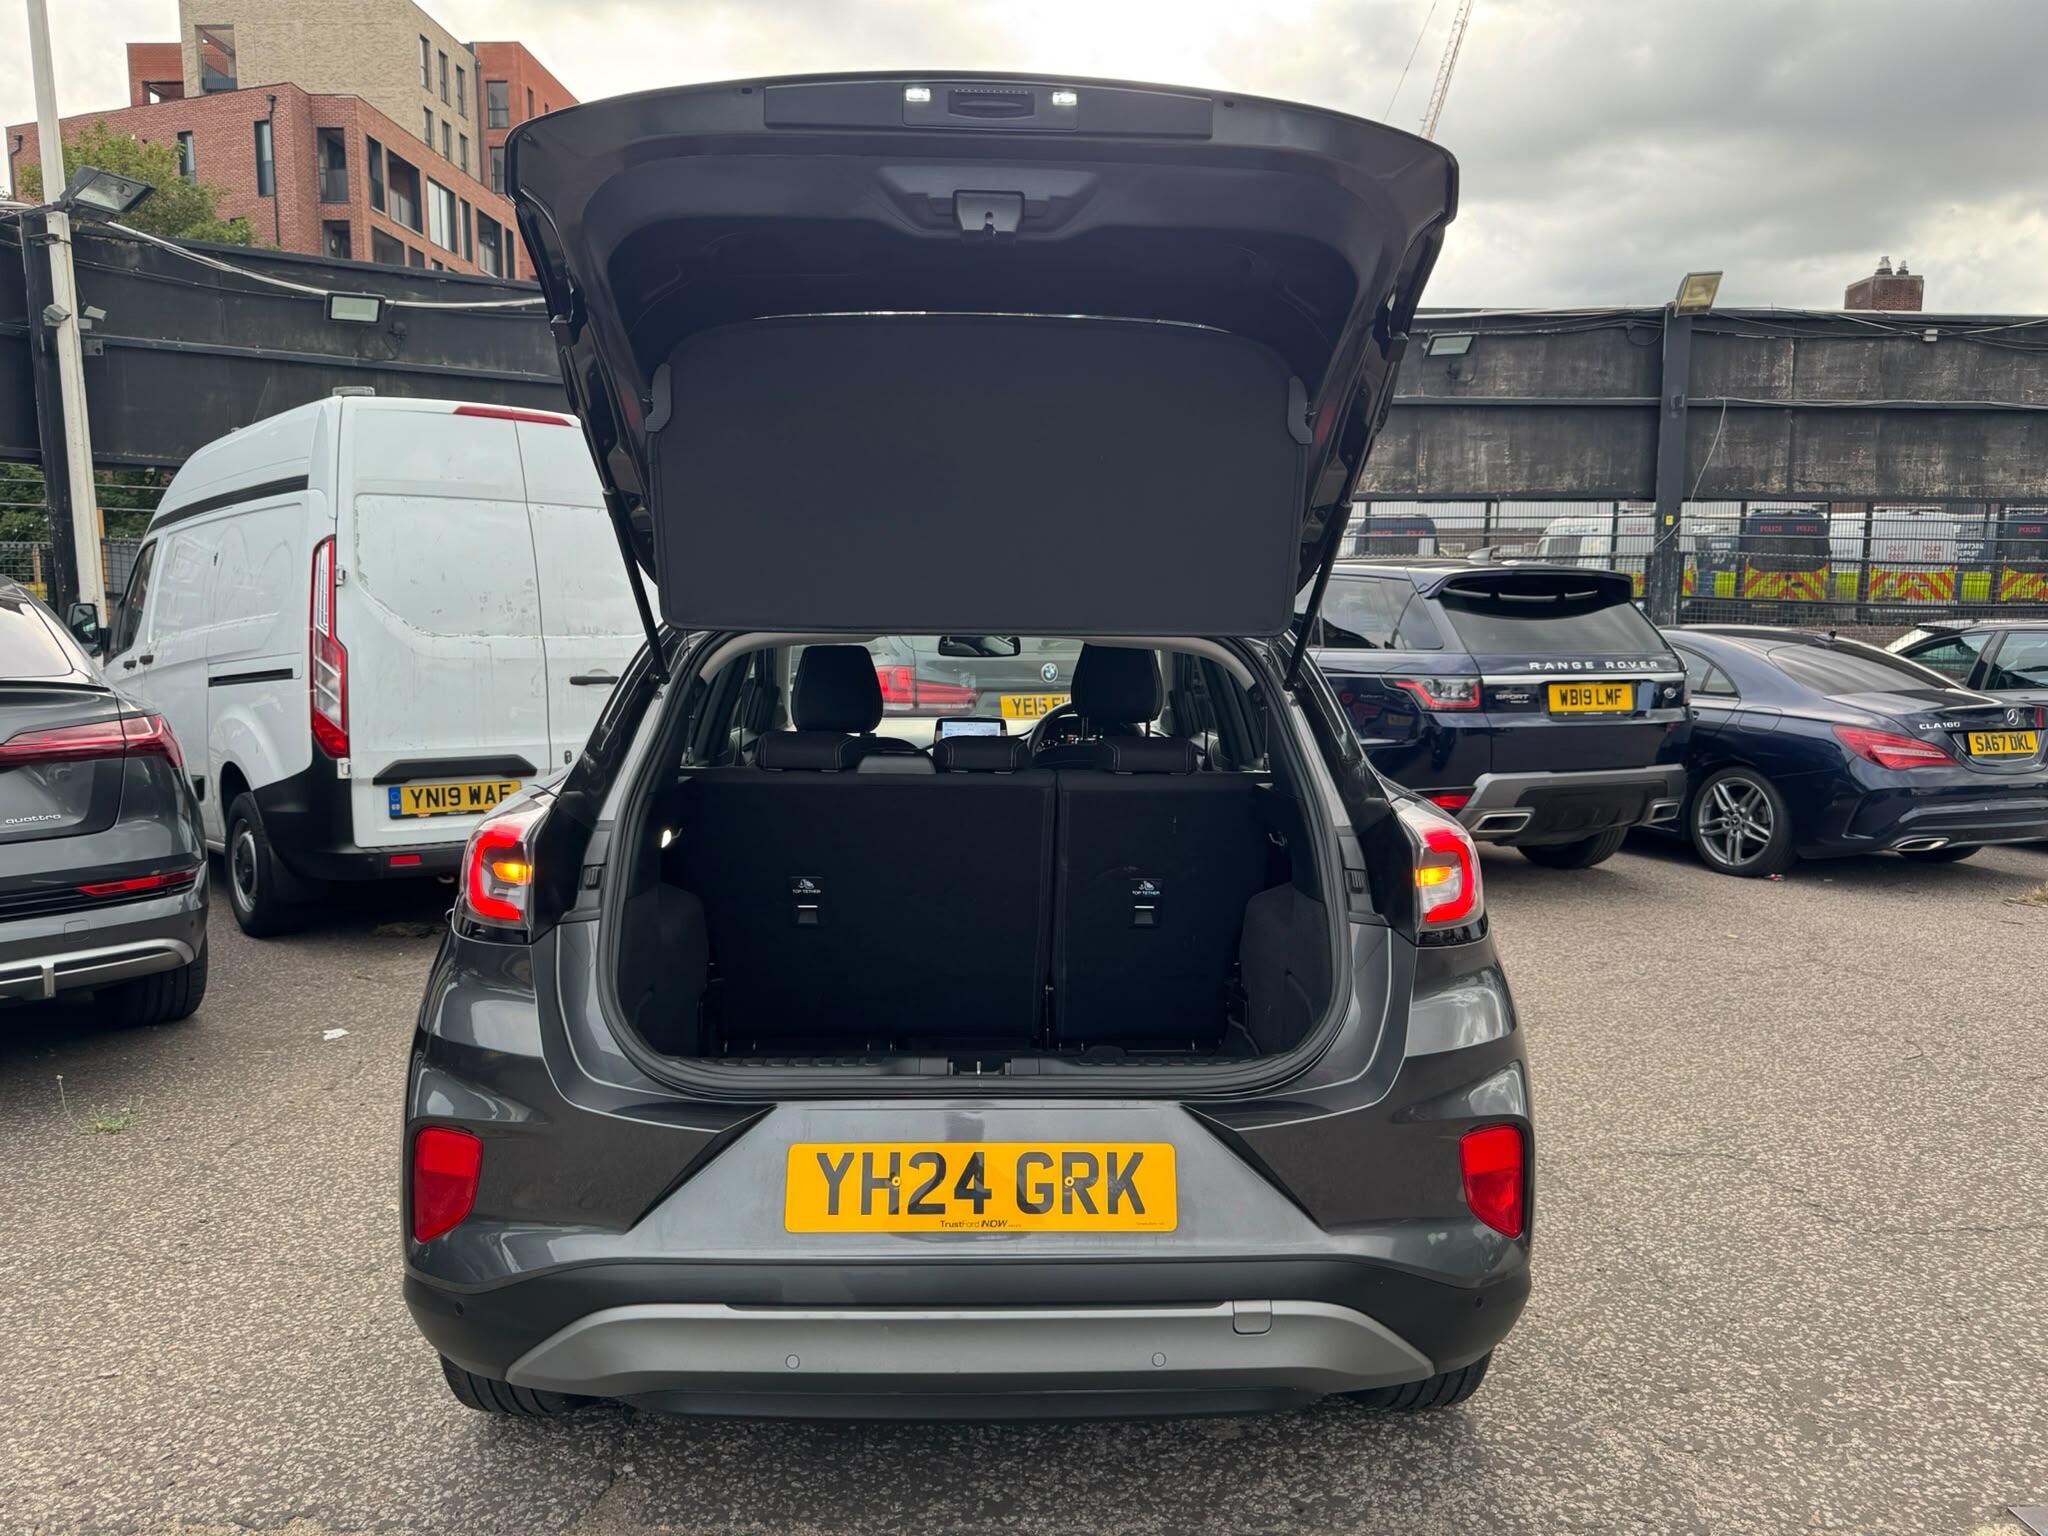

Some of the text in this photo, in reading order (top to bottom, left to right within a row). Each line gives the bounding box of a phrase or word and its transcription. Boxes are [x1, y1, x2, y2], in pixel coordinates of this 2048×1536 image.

[1528, 661, 1659, 671] RANGE ROVER
[1559, 688, 1622, 706] WB19 LMF
[1012, 697, 1048, 716] YE15
[1975, 733, 2033, 752] SA67 DKL
[410, 787, 461, 809] YN19
[5, 814, 61, 825] quattro
[816, 1151, 1146, 1216] YH24 GRK
[981, 1219, 1008, 1228] NOW
